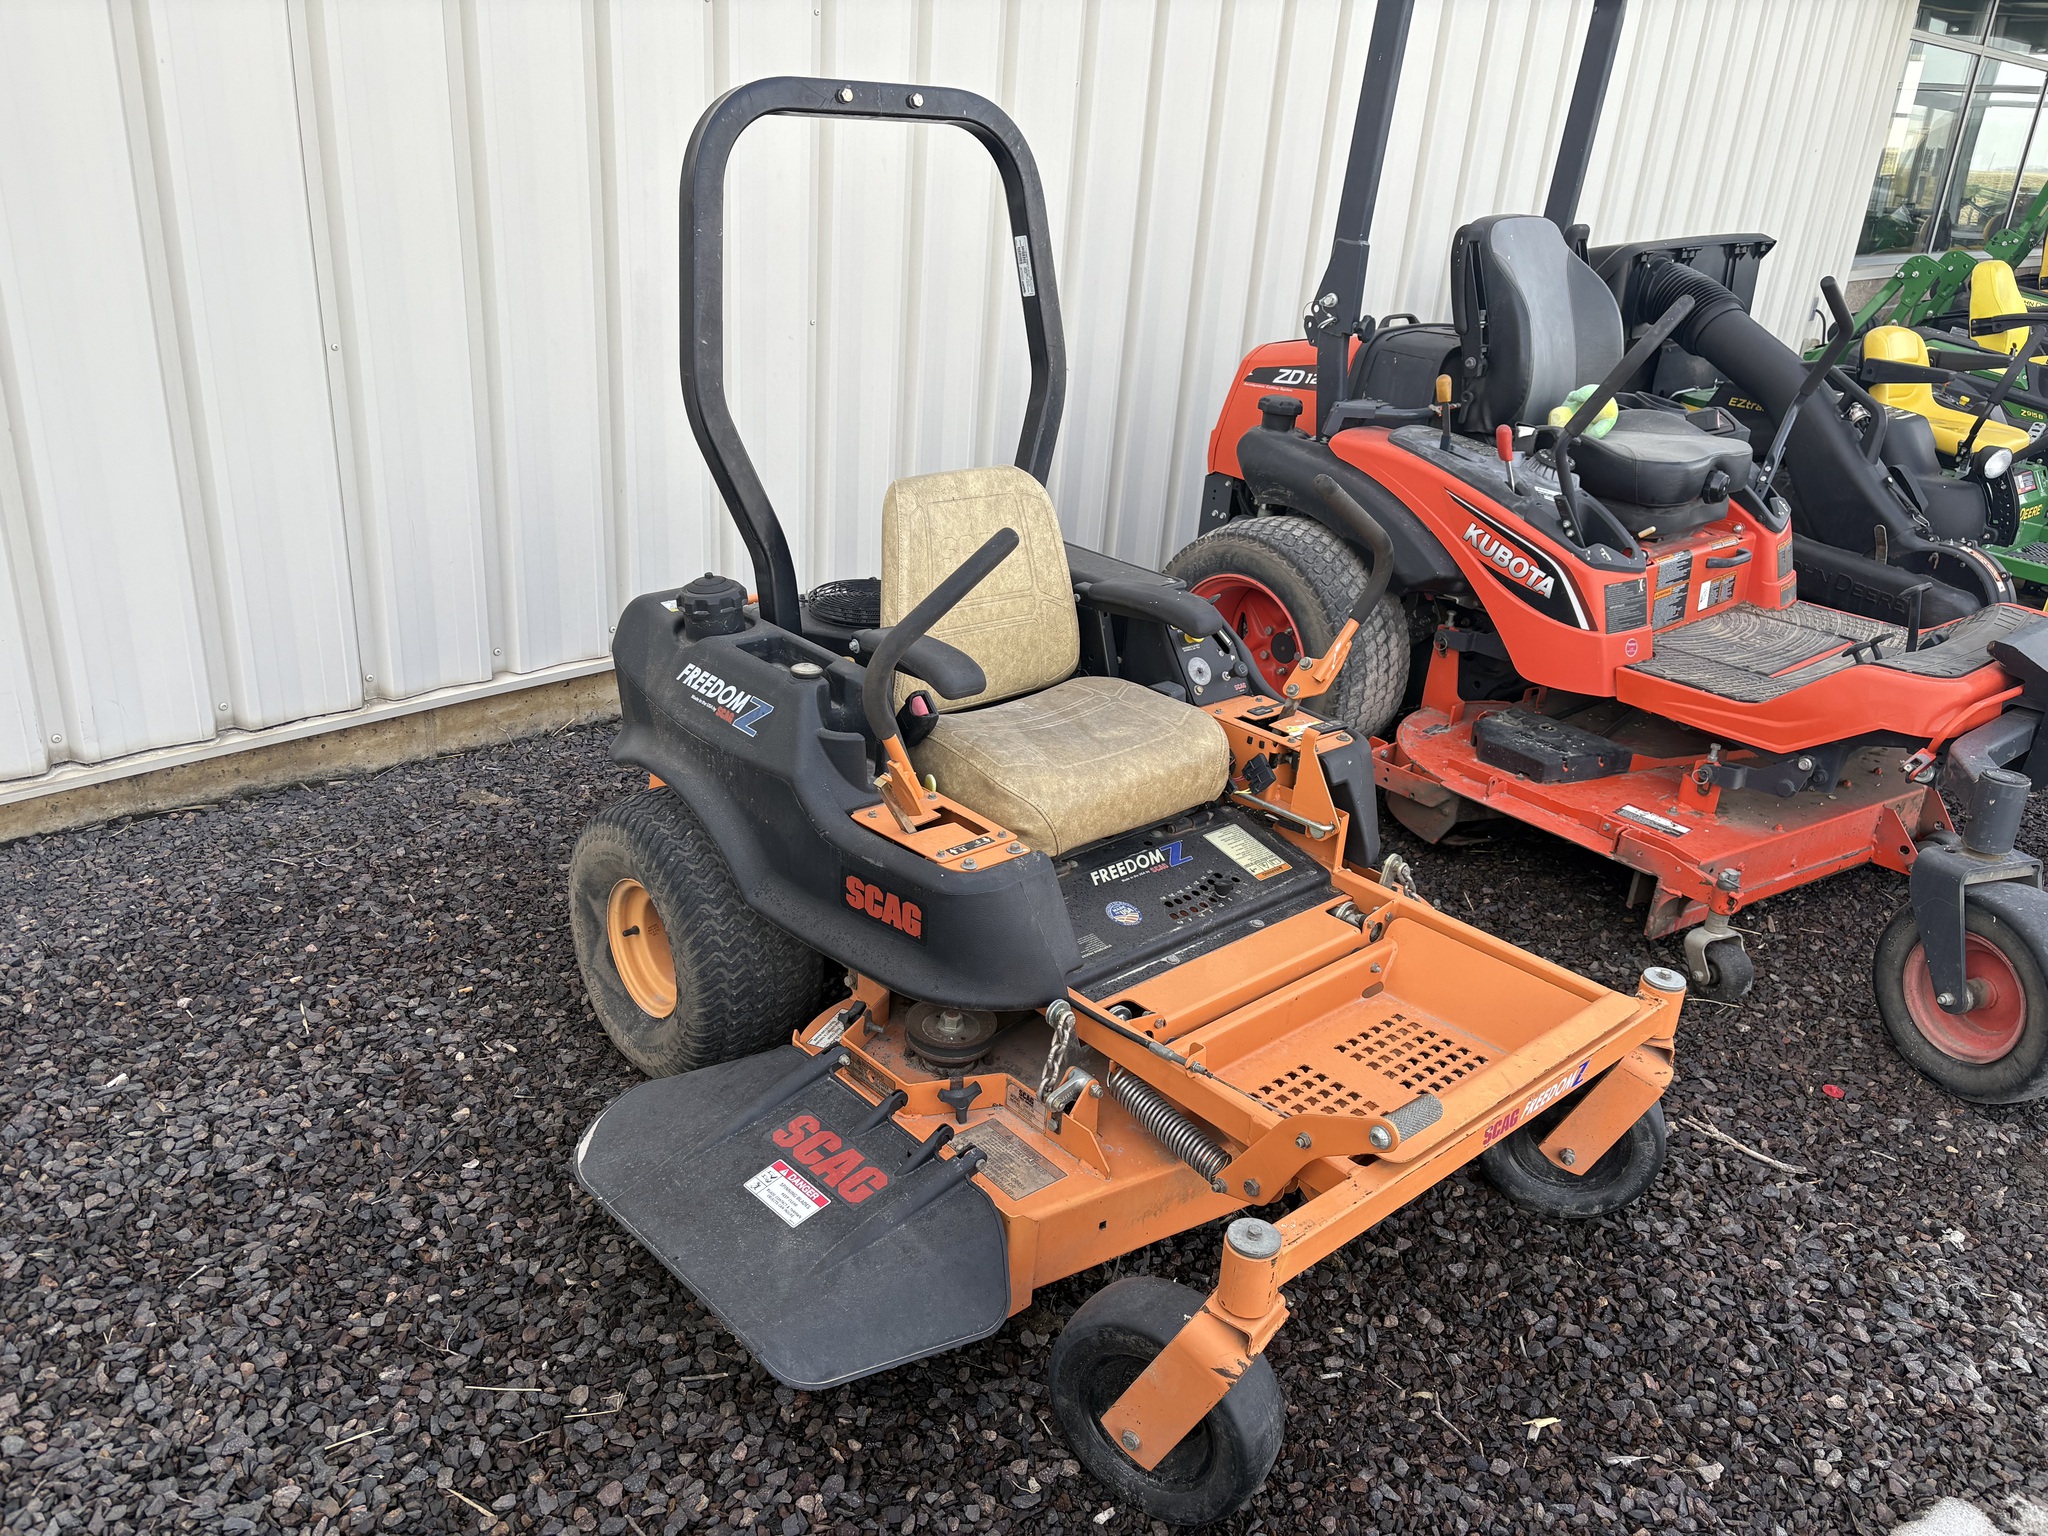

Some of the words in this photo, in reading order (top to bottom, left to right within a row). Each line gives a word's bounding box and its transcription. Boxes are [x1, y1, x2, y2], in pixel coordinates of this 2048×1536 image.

[1272, 368, 1306, 385] ZD
[1728, 396, 1765, 412] EZtra
[1462, 521, 1556, 600] KUBOTA
[675, 662, 752, 715] FREEDOM
[731, 695, 775, 738] Z
[1089, 848, 1166, 887] FREEDOM
[1159, 840, 1194, 868] Z
[845, 875, 923, 938] SCAG
[1482, 1107, 1521, 1146] SCAG
[1519, 1069, 1579, 1121] FREEDOM
[1571, 1058, 1592, 1088] Z
[771, 1114, 889, 1204] SCAG
[786, 1173, 820, 1200] DANGER
[778, 1182, 798, 1198] SPINNING
[795, 1195, 811, 1209] BLADES
